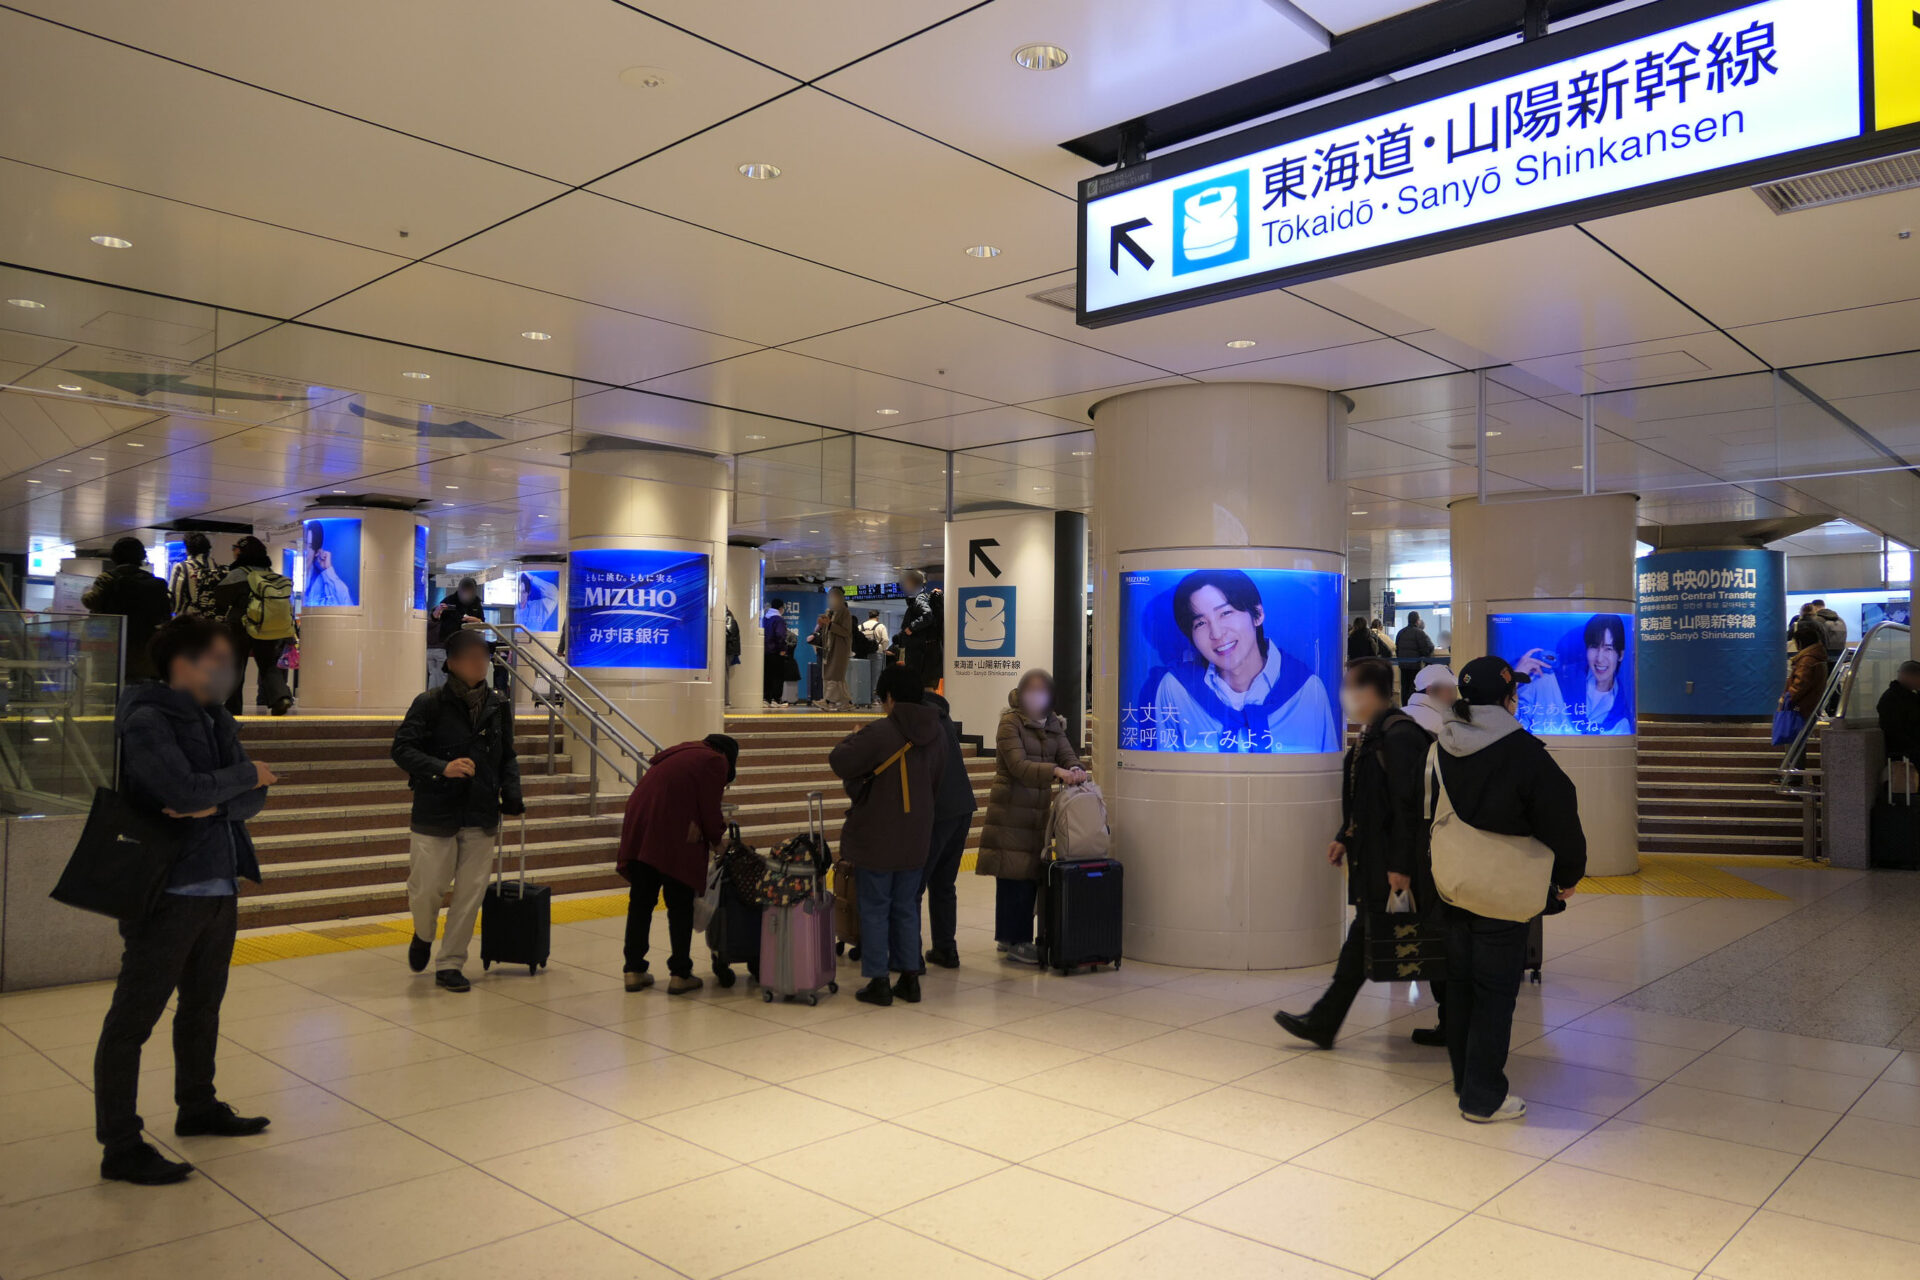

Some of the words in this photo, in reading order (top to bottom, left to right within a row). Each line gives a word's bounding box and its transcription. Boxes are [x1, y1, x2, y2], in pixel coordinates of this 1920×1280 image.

[1262, 20, 1779, 211] 東海道・山陽新幹線
[1515, 109, 1744, 186] Shinkansen
[1639, 571, 1669, 593] 新幹線
[1672, 568, 1757, 590] 中央のりかえ口
[584, 587, 677, 608] MIZUHO
[1681, 591, 1716, 601] Central
[1718, 590, 1757, 600] Transfer
[1640, 614, 1756, 631] 東海道・山陽新幹線
[589, 627, 670, 644] みずほ銀行
[1701, 630, 1755, 640] Shinkansen
[1121, 702, 1190, 724] 大丈夫、
[1519, 718, 1605, 733] と休んでね。
[1121, 727, 1283, 750] 深呼吸してみよう。
